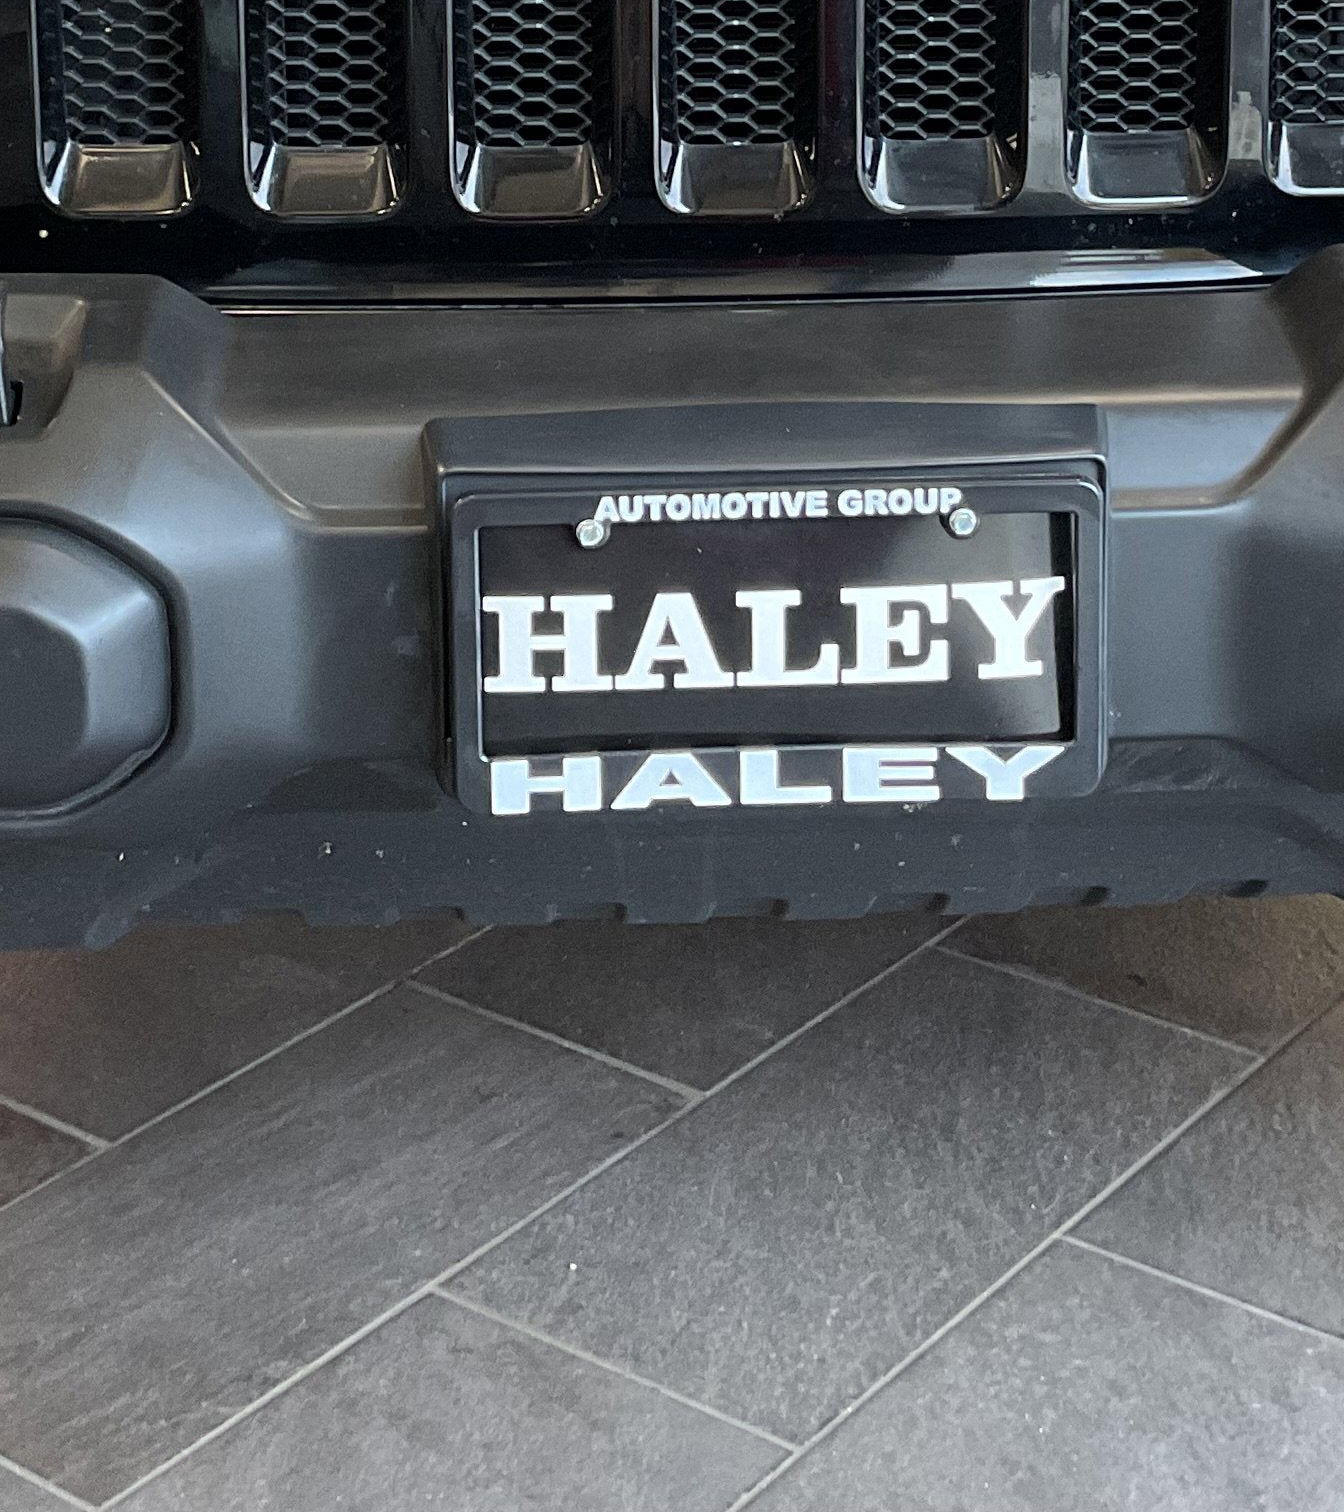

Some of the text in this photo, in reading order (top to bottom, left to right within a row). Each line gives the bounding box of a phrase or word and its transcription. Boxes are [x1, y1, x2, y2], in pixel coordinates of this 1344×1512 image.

[594, 487, 963, 522] AUTOMOTIVE GROUP
[482, 575, 1066, 693] HALEY
[490, 745, 1066, 816] HALEY
